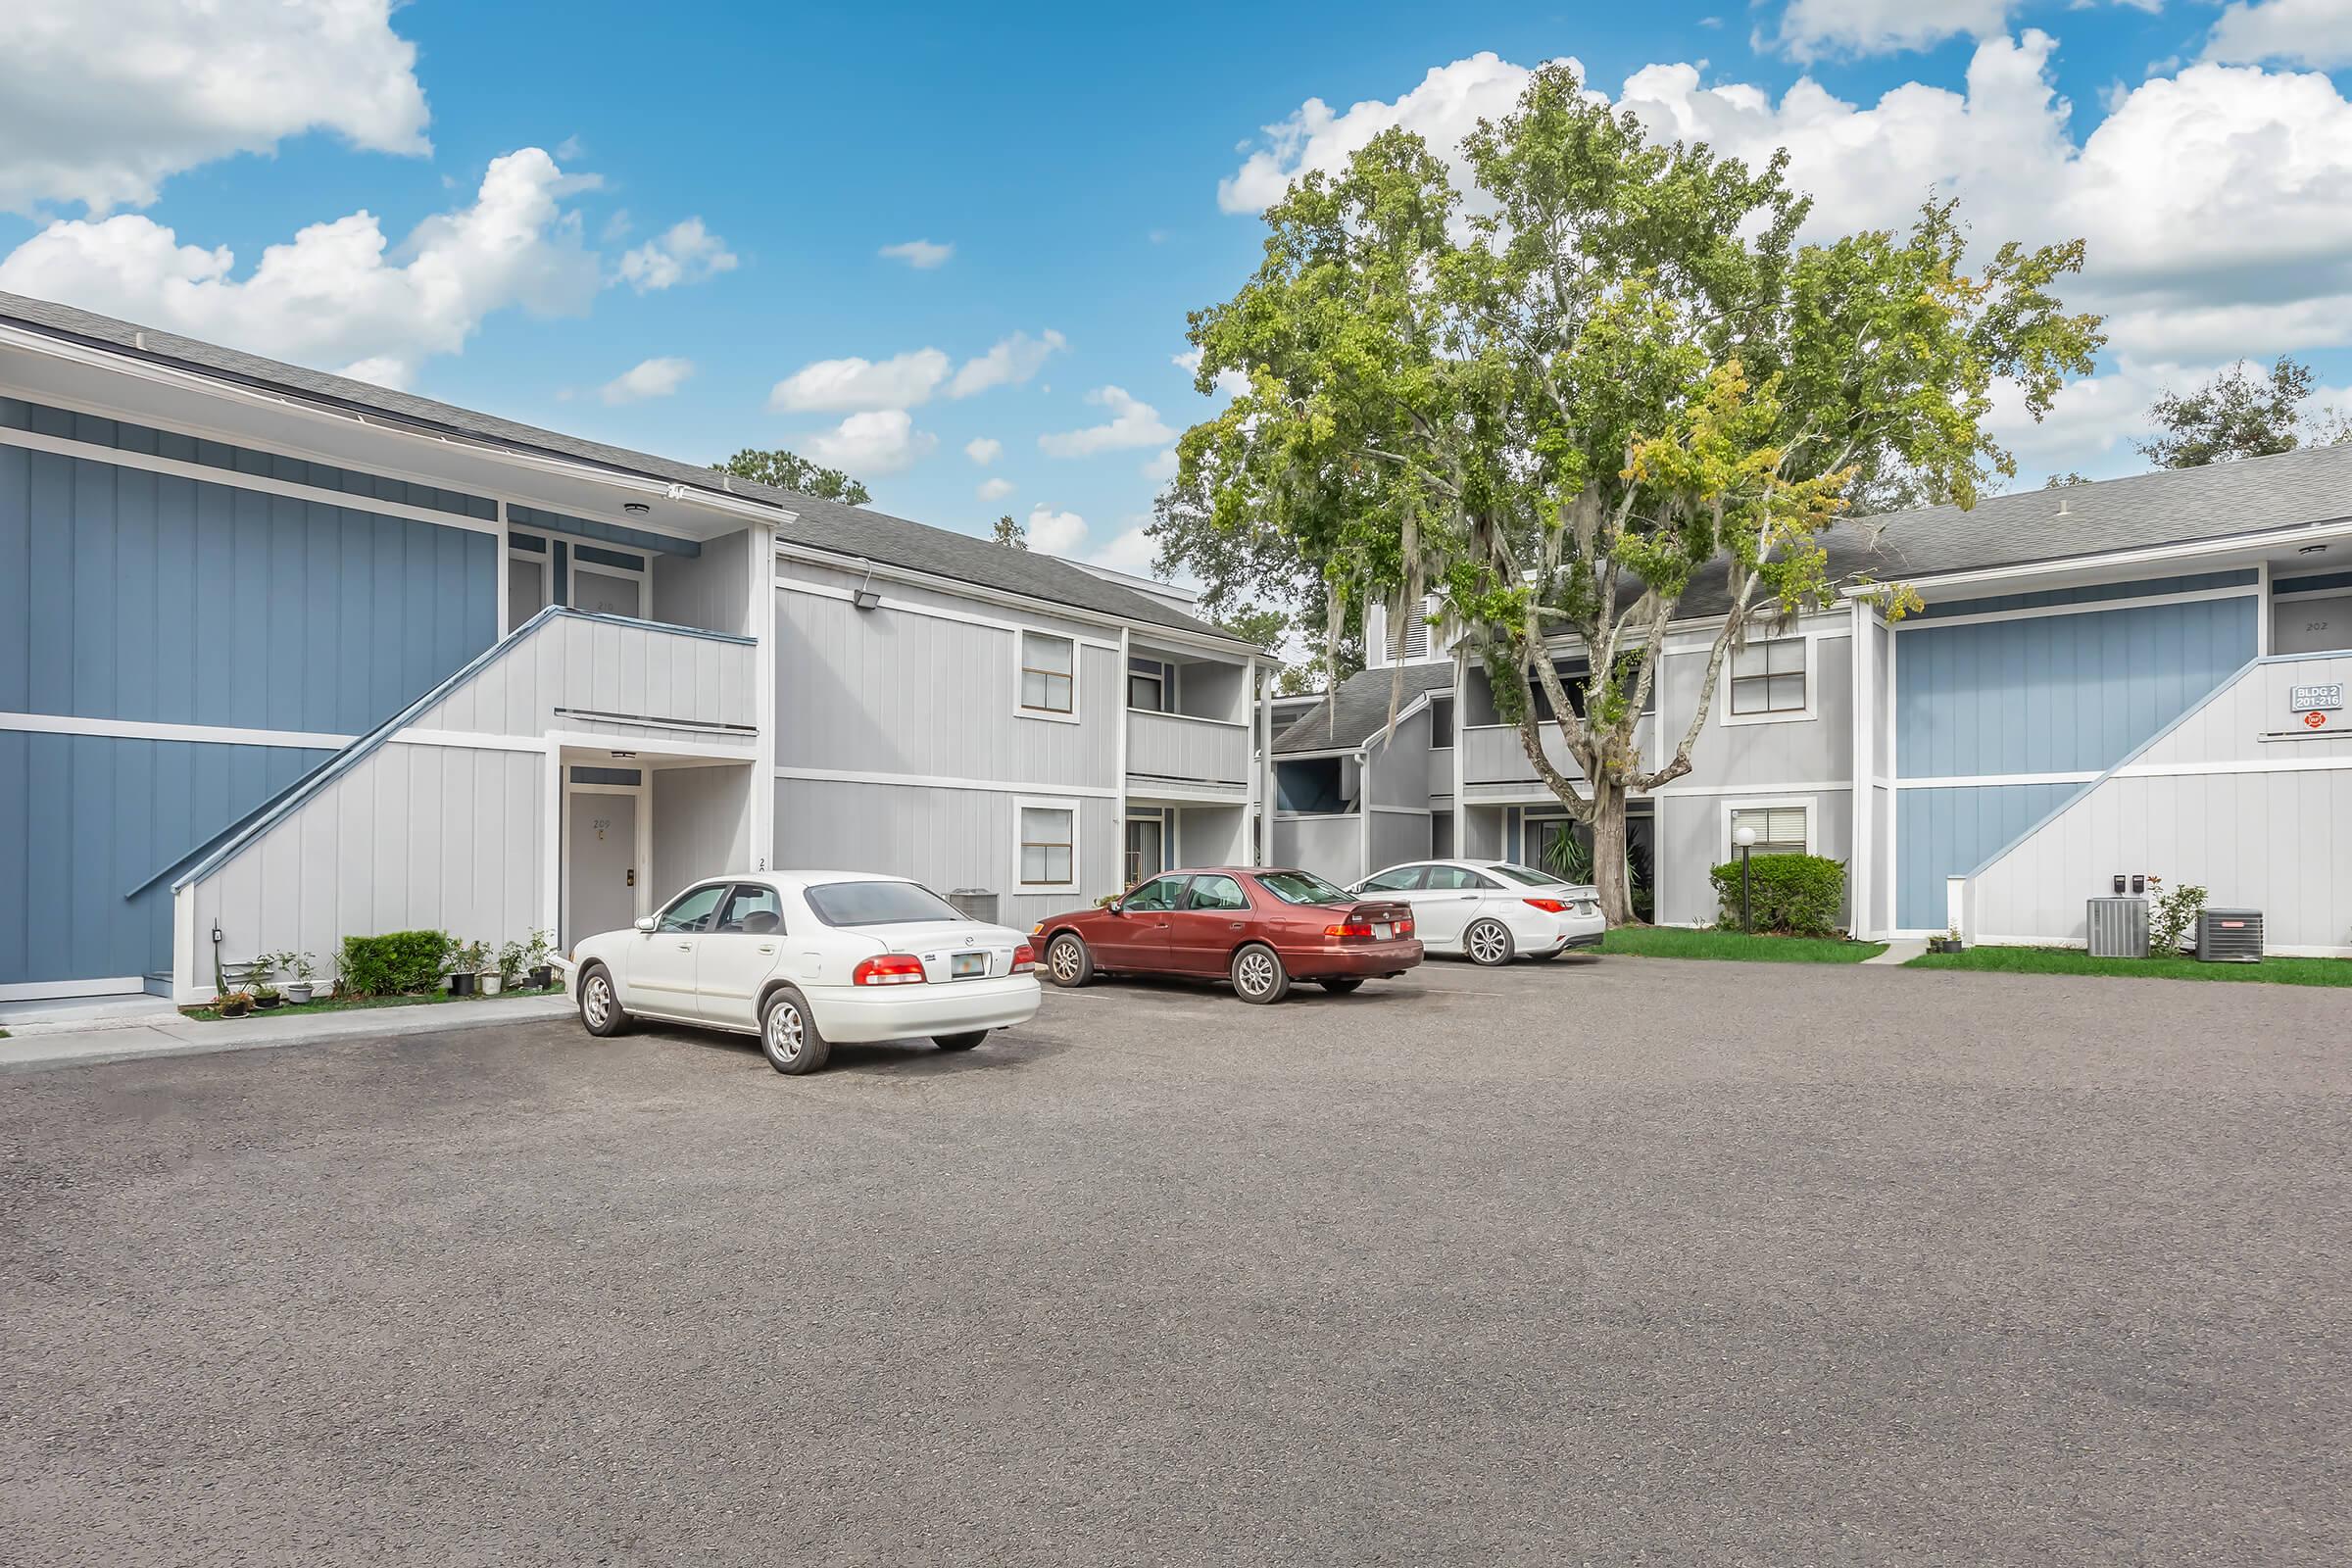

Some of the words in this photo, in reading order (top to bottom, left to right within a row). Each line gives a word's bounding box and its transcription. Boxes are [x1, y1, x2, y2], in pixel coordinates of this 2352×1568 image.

[2306, 621, 2328, 632] 202
[2297, 687, 2328, 697] BLDG
[2329, 686, 2338, 696] 2
[2296, 696, 2339, 707] 201-216
[593, 819, 611, 829] 209
